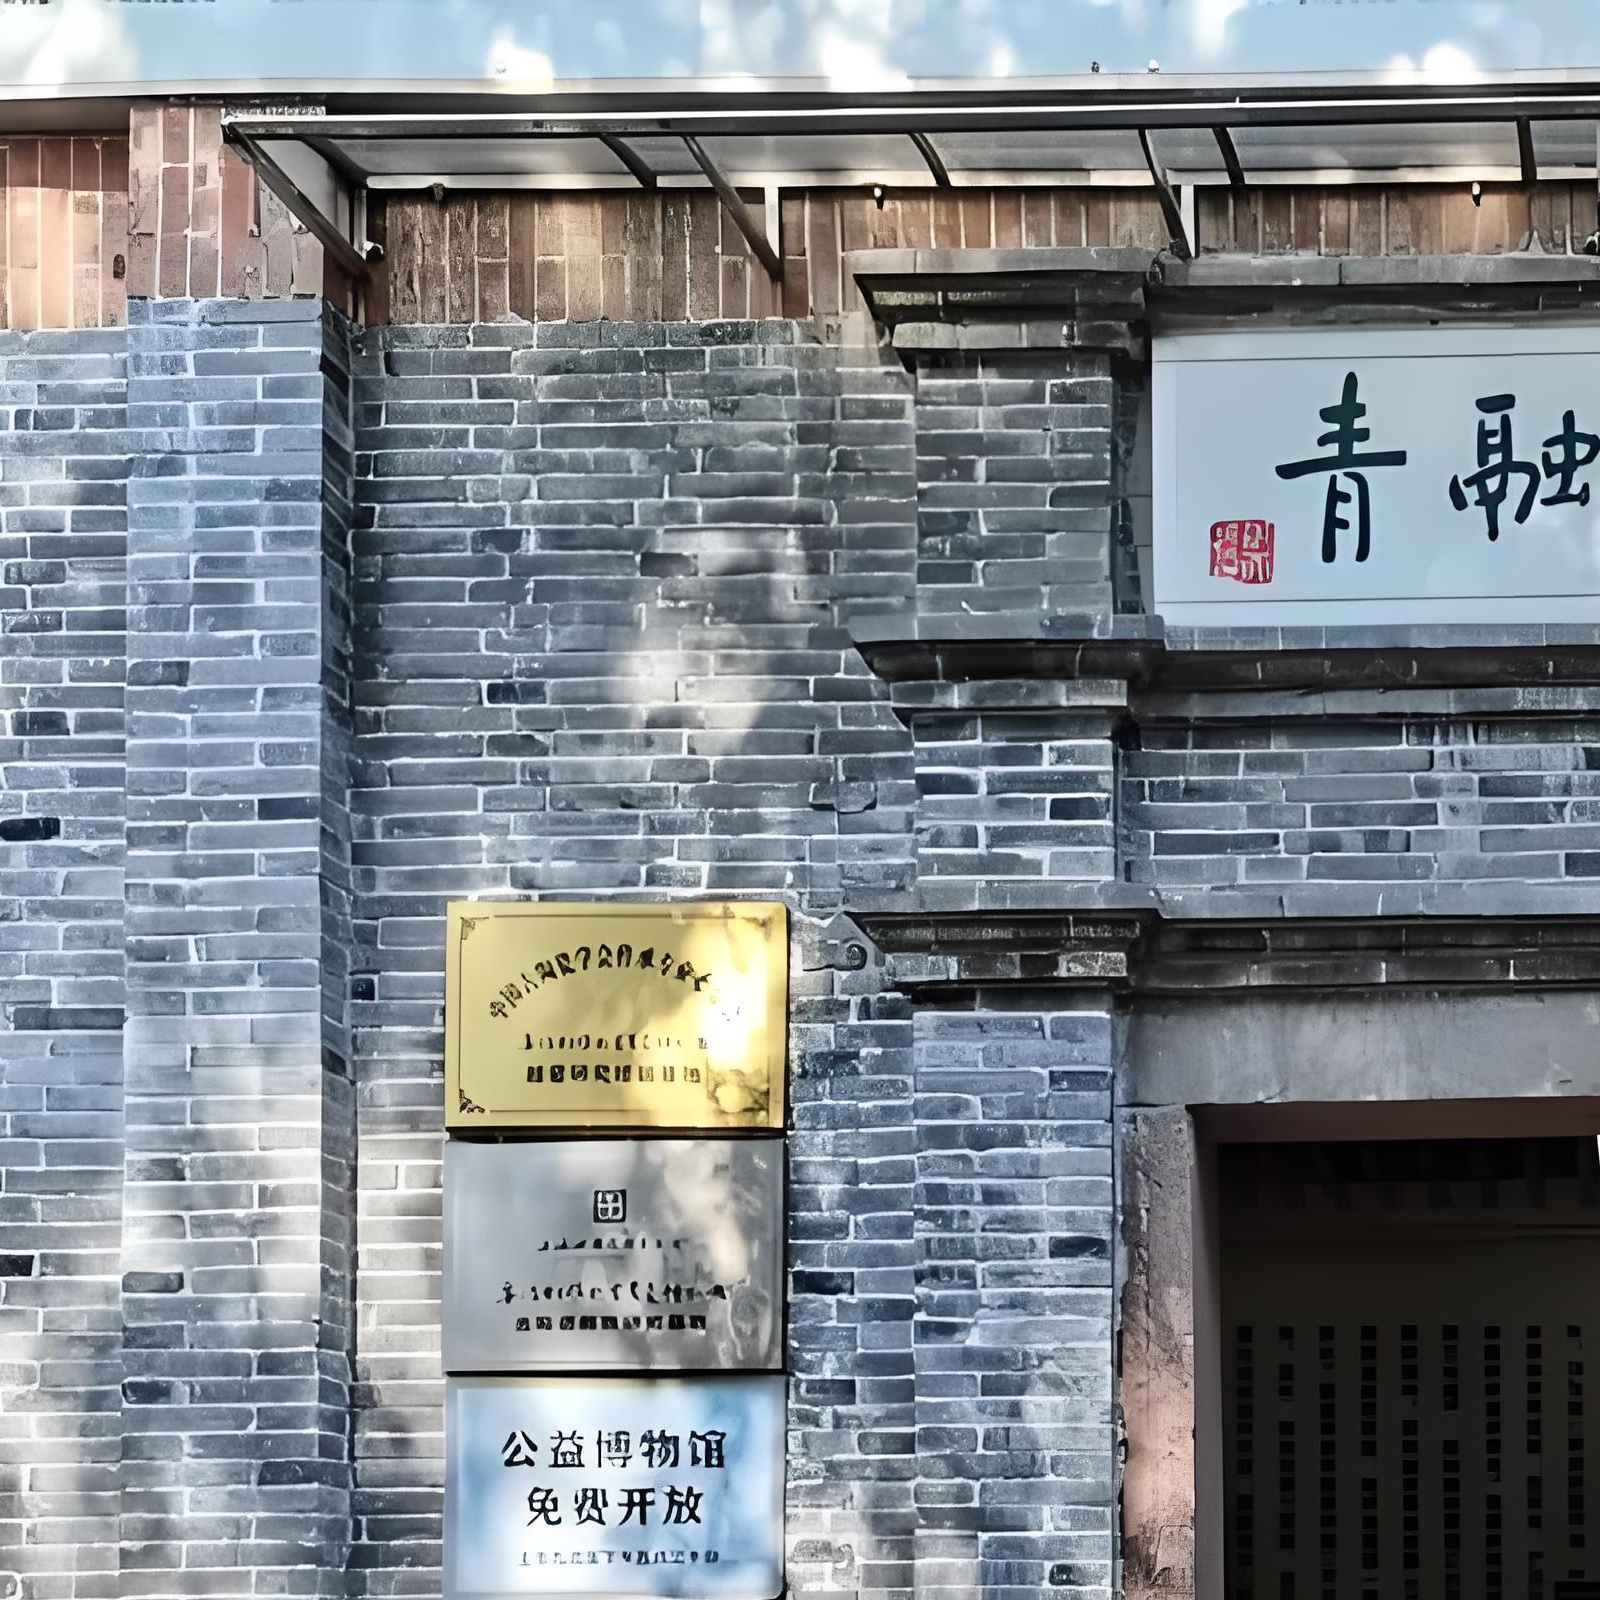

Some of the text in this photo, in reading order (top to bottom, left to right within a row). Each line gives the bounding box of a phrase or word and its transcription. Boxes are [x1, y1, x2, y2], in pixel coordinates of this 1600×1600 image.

[501, 1429, 727, 1468] 公益博物馆
[526, 1485, 704, 1527] 免费开放
